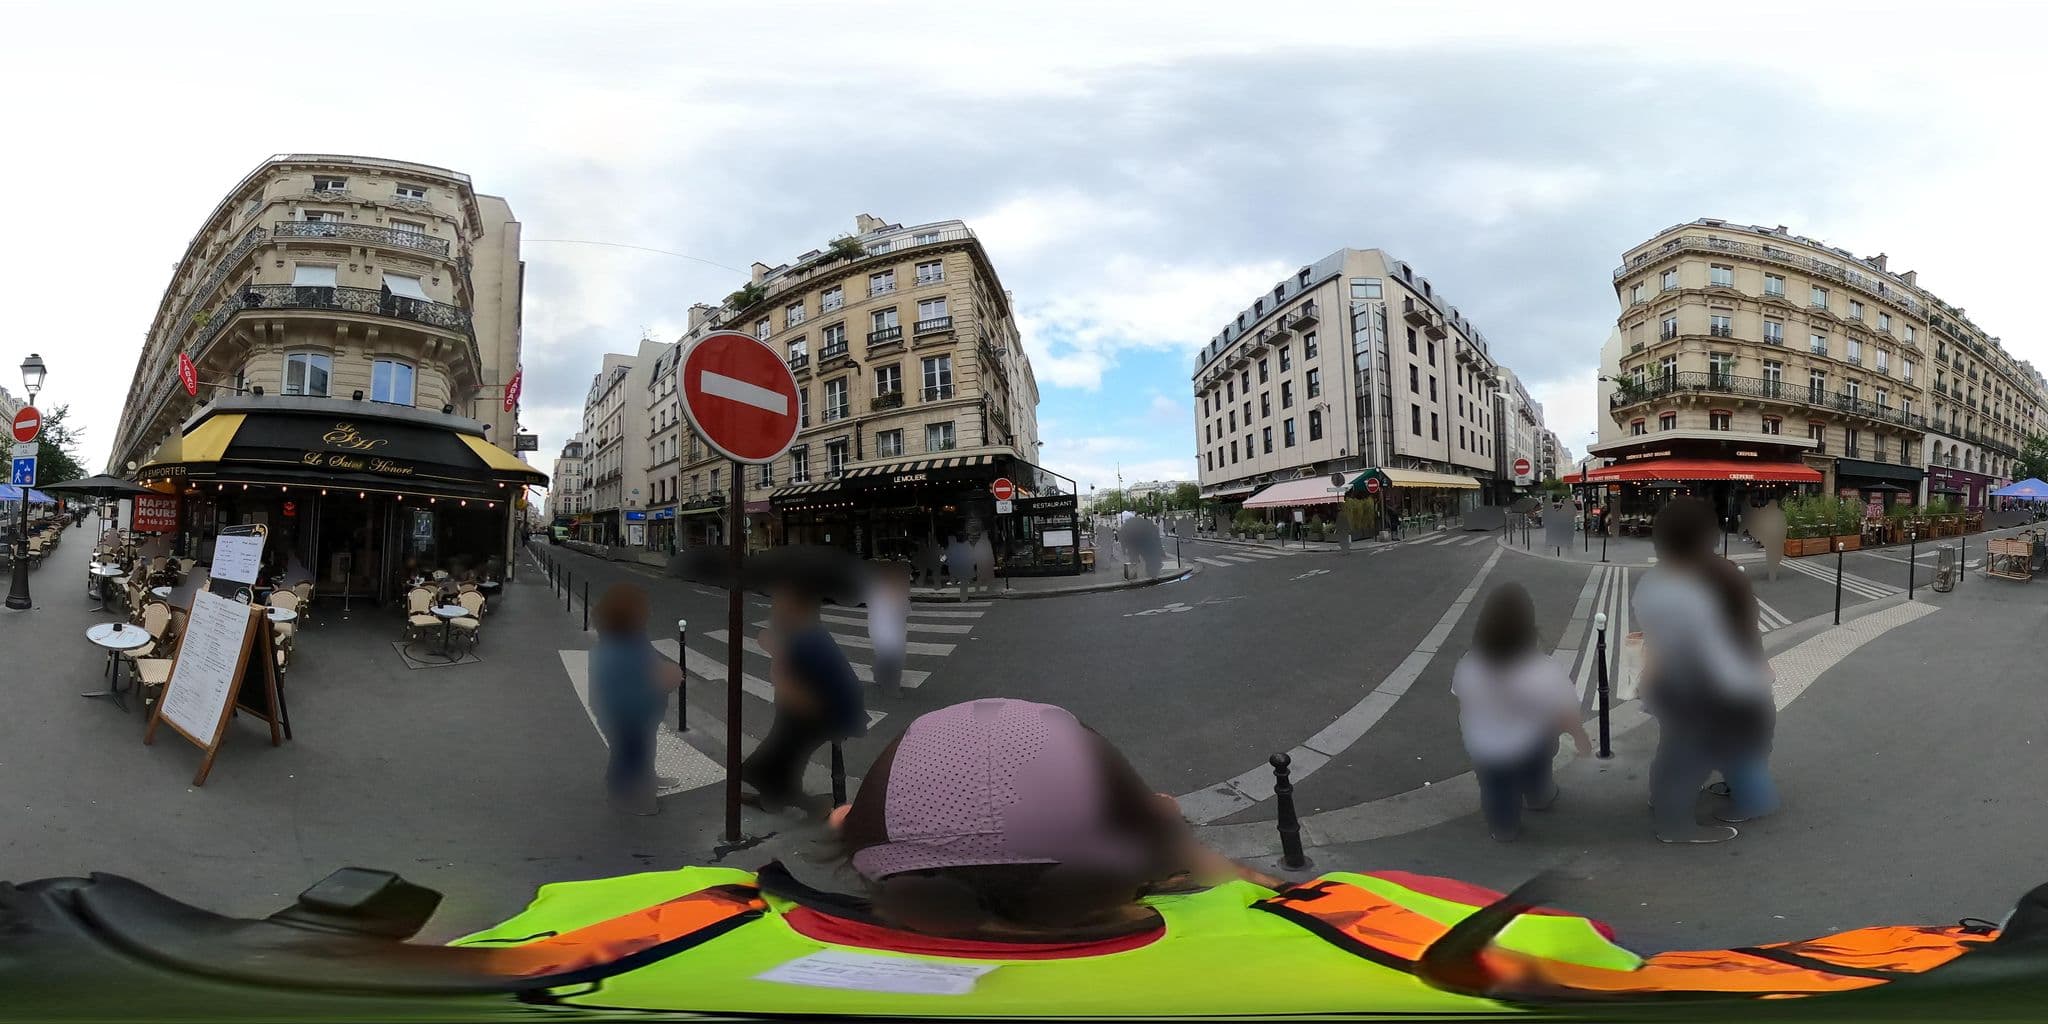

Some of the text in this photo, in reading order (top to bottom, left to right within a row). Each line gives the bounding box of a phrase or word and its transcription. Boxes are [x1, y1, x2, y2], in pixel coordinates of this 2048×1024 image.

[183, 359, 194, 389] TABAC
[506, 377, 520, 405] TABAC
[303, 452, 323, 466] Le
[368, 458, 414, 475] Honoré
[148, 466, 187, 478] EMPORTER
[139, 498, 177, 508] HAPPY
[1032, 500, 1073, 508] RESTAURANT
[139, 508, 177, 518] HOURS
